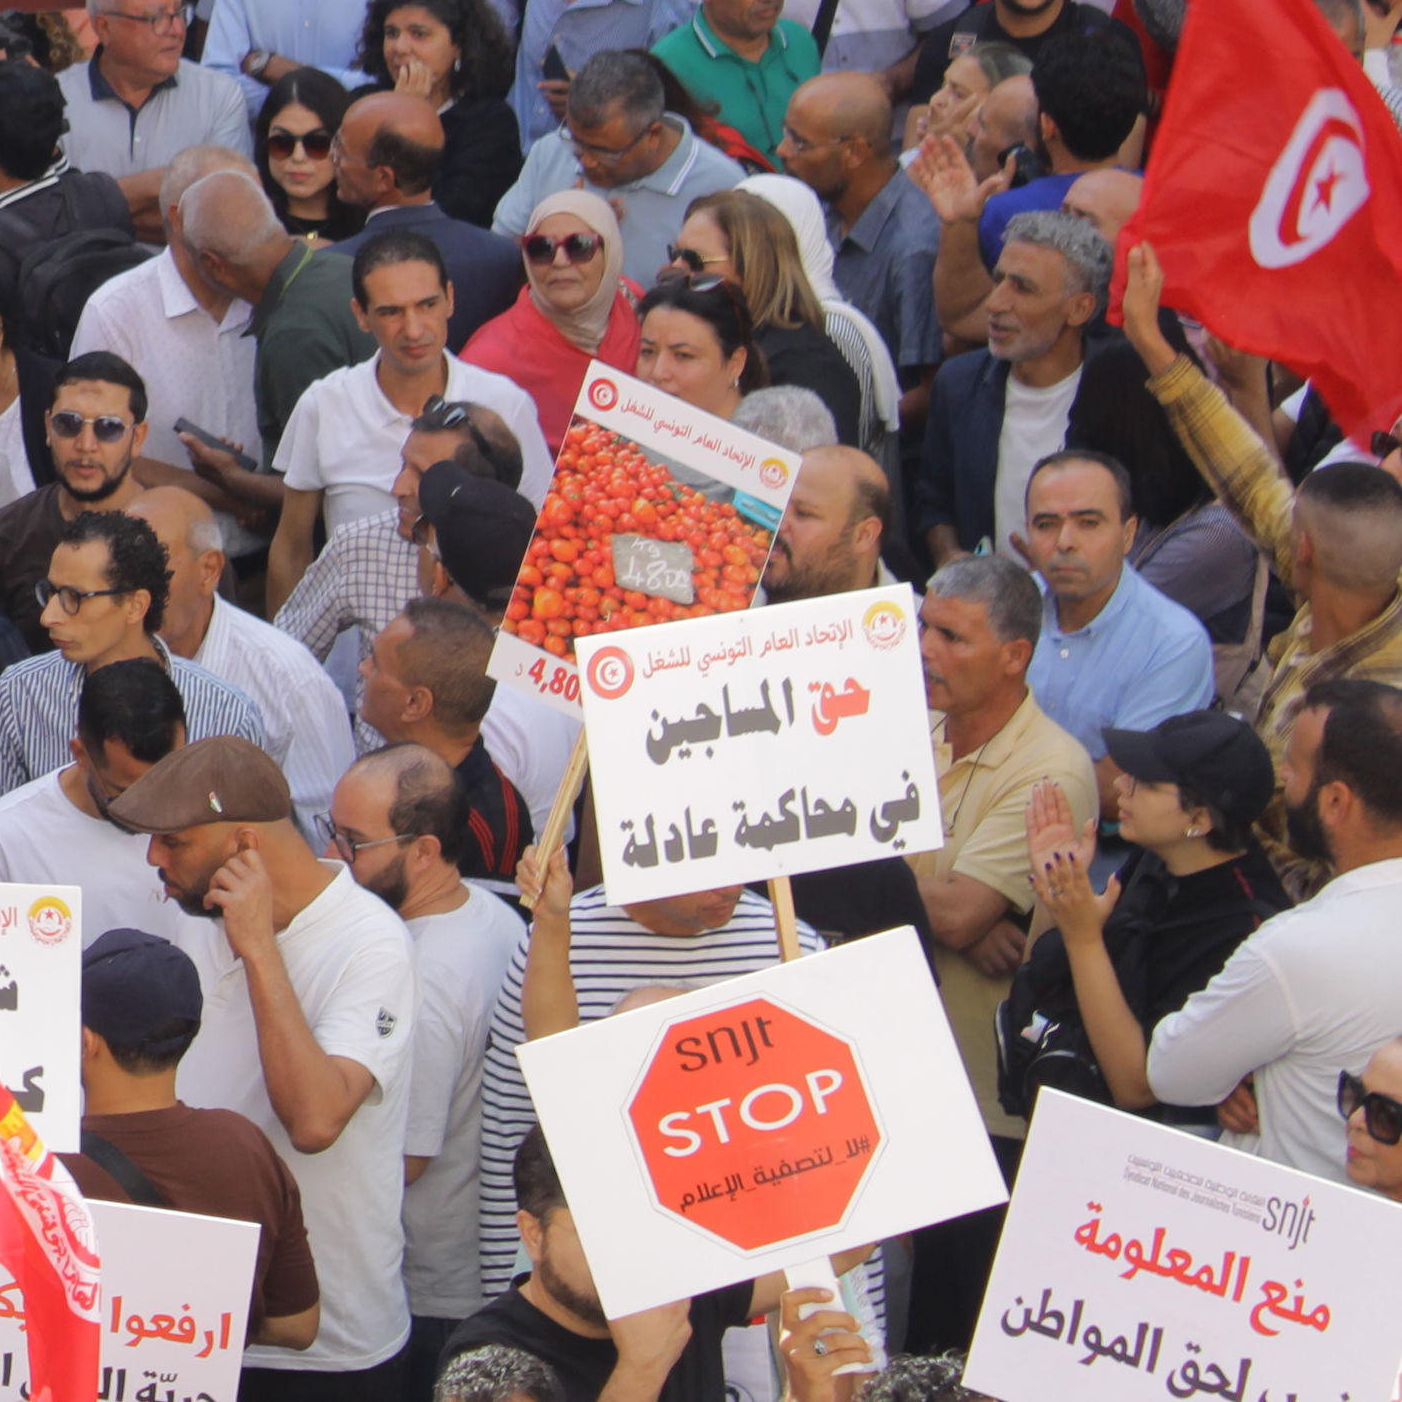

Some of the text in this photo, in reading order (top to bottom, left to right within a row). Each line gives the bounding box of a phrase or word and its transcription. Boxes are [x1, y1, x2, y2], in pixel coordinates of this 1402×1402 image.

[620, 398, 655, 419] للشغل
[653, 417, 693, 438] التونسي
[693, 432, 722, 454] العام
[642, 645, 692, 679] للشغل
[696, 637, 753, 678] التونسي
[759, 631, 800, 659] العام
[645, 676, 871, 765] حق المساجين
[620, 769, 921, 869] في محاكمة عادلة
[657, 1069, 844, 1158] STOP
[1073, 1199, 1331, 1337] منع المعلومة
[110, 1296, 232, 1358] ارفعوا
[1000, 1287, 1164, 1375] المواطن
